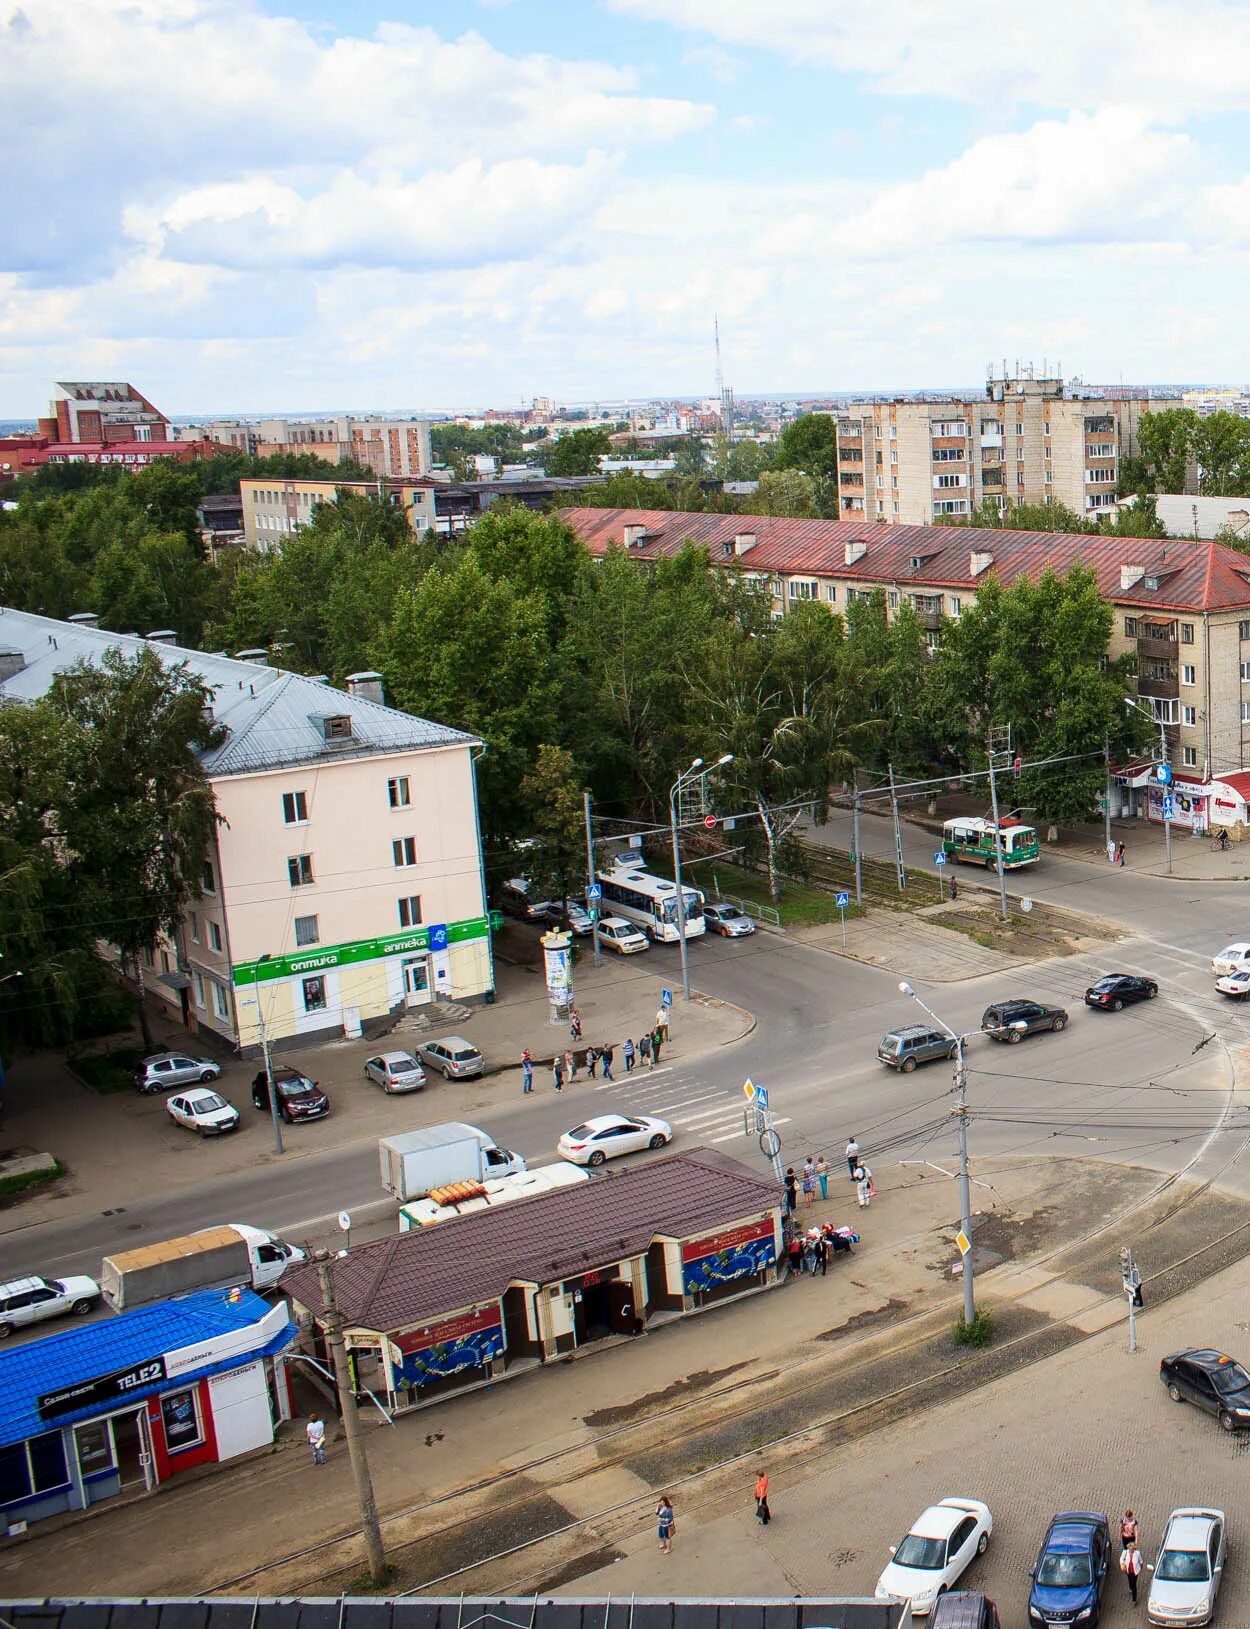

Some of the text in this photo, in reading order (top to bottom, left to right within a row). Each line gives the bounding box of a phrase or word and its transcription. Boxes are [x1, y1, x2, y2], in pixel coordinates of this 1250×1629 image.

[383, 937, 427, 953] аптека
[290, 955, 338, 972] оптика
[117, 1362, 162, 1391] TELE2
